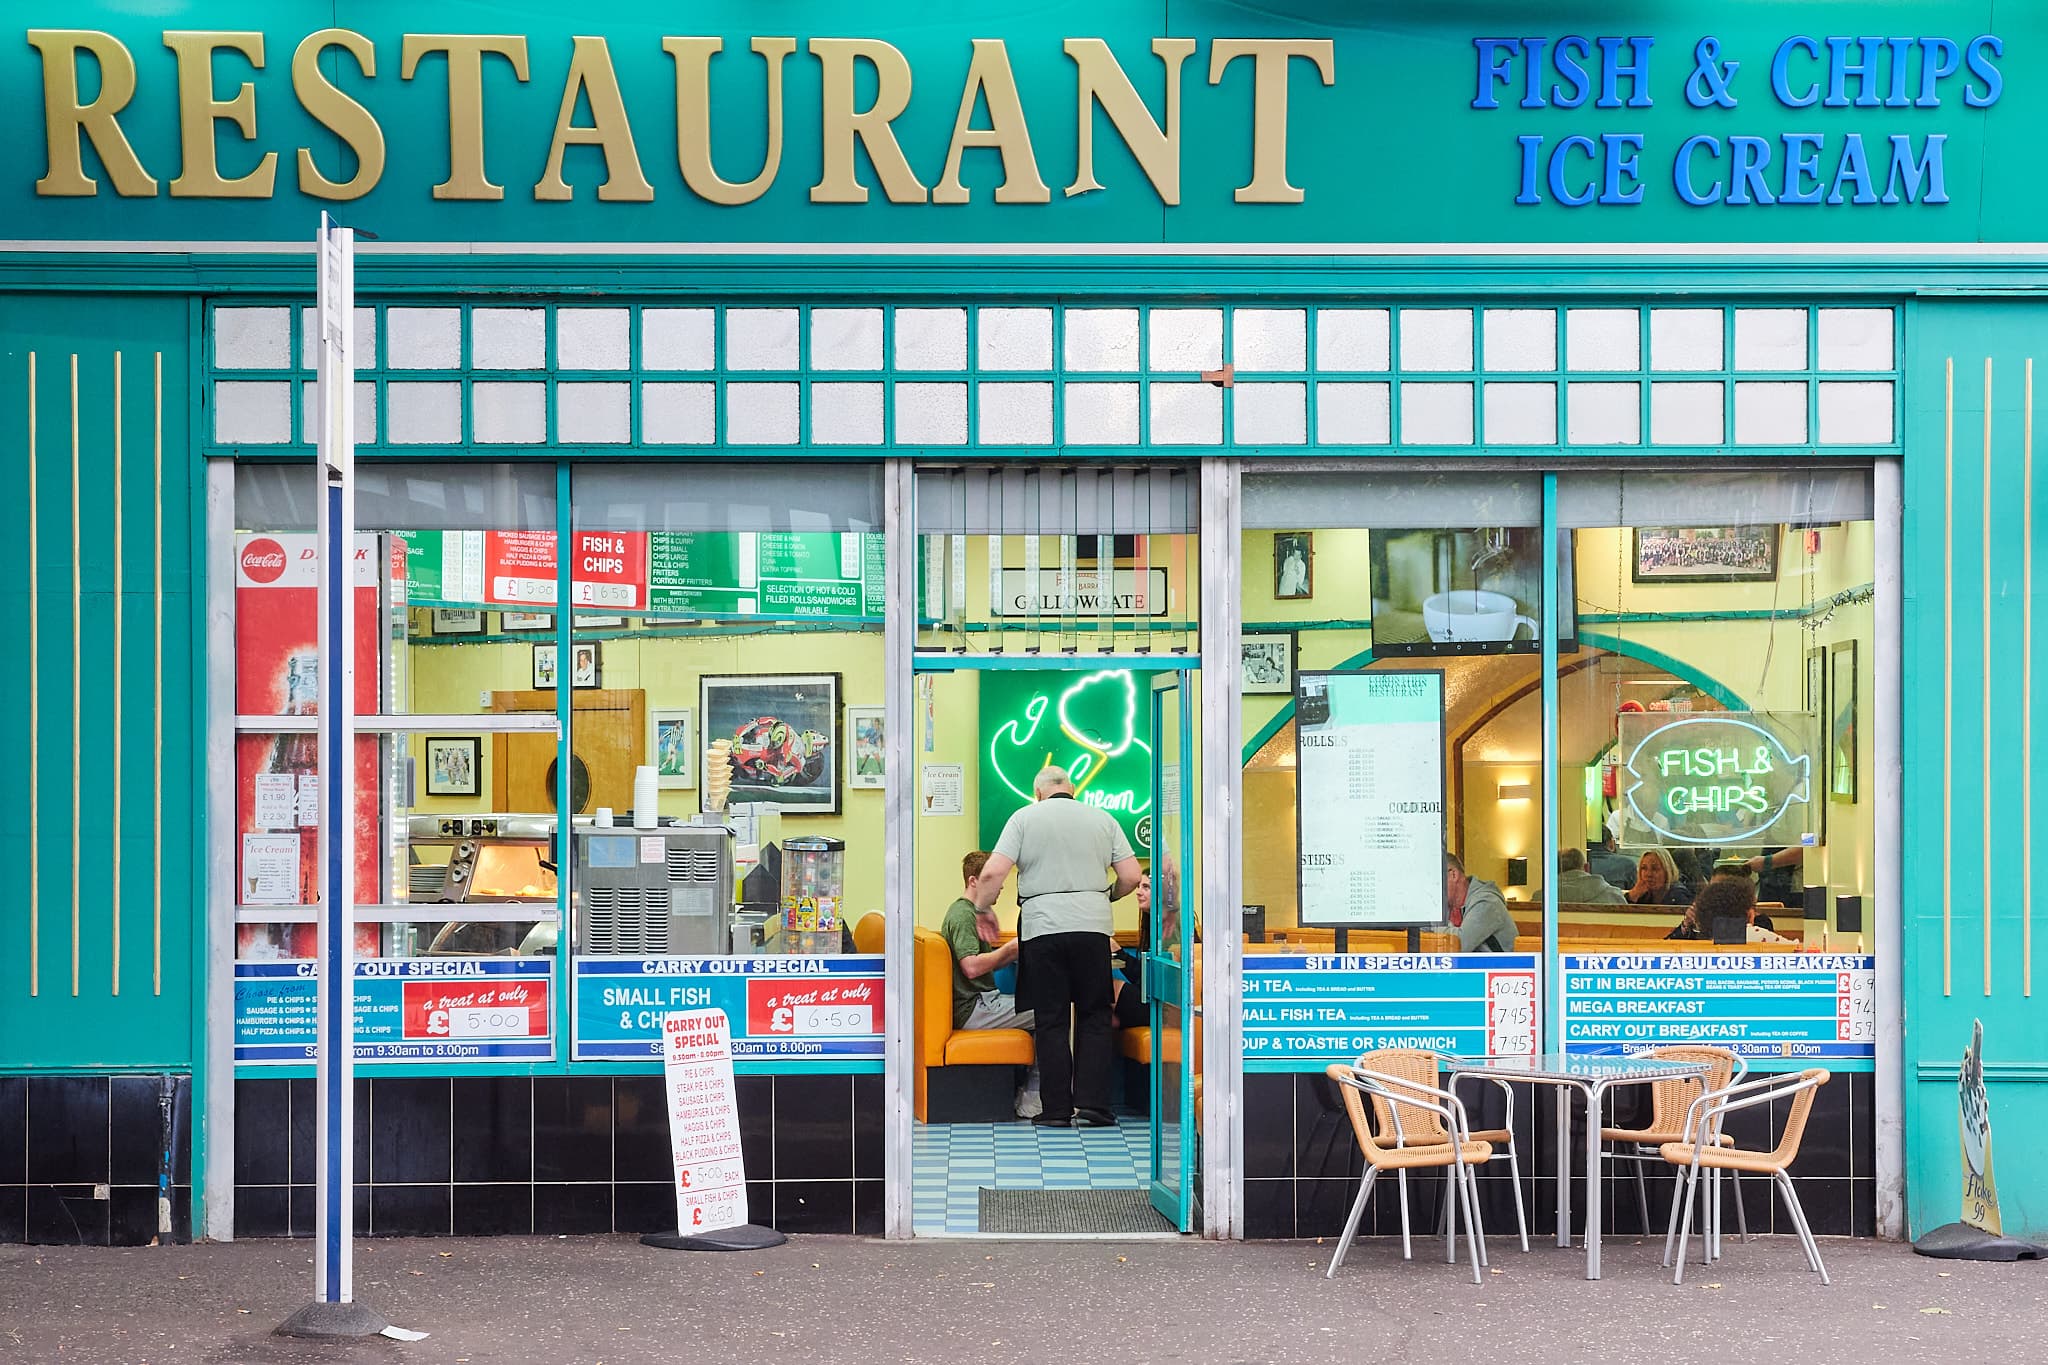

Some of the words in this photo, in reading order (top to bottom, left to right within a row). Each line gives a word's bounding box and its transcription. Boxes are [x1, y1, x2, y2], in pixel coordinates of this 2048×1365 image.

[1471, 35, 1654, 108] FISH
[1686, 36, 1737, 107] &
[1772, 35, 2003, 108] CHIPS
[27, 28, 1335, 206] RESTAURANT
[1515, 134, 1644, 205] ICE
[1674, 134, 1949, 205] CREAM
[583, 537, 612, 553] FISH
[615, 539, 624, 554] &
[584, 557, 623, 573] CHIPS
[767, 585, 804, 593] SELECTION
[766, 595, 788, 603] FILLED
[790, 596, 856, 605] ROLLS/SANDWICHES
[1015, 595, 1144, 609] GALLOWGATE
[795, 606, 828, 614] AVAILABLE
[1662, 749, 1740, 776] FISH
[1667, 786, 1768, 814] CHIPS
[1389, 802, 1417, 813] COLD
[365, 963, 402, 975] OUT
[409, 962, 485, 975] SPECIAL
[642, 961, 703, 974] CARRY
[709, 960, 748, 973] OUT
[752, 960, 829, 973] SPECIAL
[1306, 957, 1335, 970] SIT
[1341, 957, 1359, 969] IN
[1365, 956, 1452, 970] SPECIALS
[1576, 957, 1615, 969] TRY
[1617, 957, 1656, 969] OUT
[1661, 957, 1755, 969] FABULOUS
[1761, 957, 1866, 969] BREAKFAST
[1264, 980, 1292, 992] TEA
[1571, 978, 1593, 989] SIT
[1597, 978, 1611, 989] IN
[1616, 978, 1704, 989] BREAKFAST
[1839, 975, 1849, 991] £
[279, 985, 305, 997] from
[424, 1000, 433, 1010] a
[439, 993, 474, 1008] treat
[478, 991, 495, 1004] at
[499, 985, 528, 1003] only
[604, 988, 665, 1005] SMALL
[671, 988, 711, 1005] FISH
[767, 997, 778, 1008] a
[783, 992, 816, 1006] treat
[822, 989, 838, 1002] at
[842, 983, 871, 999] only
[1570, 1002, 1612, 1013] MEGA
[1617, 1001, 1705, 1013] BREAKFAST
[620, 1013, 633, 1028] &
[771, 1008, 792, 1032] £
[1281, 1009, 1312, 1020] FISH
[1318, 1009, 1346, 1020] TEA
[427, 1011, 448, 1034] £
[667, 1018, 701, 1032] CARRY
[705, 1016, 724, 1028] OUT
[1570, 1025, 1621, 1036] CARRY
[1625, 1025, 1656, 1036] OUT
[1660, 1025, 1748, 1036] BREAKFAST
[675, 1033, 719, 1048] SPECIAL
[1272, 1038, 1282, 1048] &
[1286, 1038, 1348, 1049] TOASTIE
[1352, 1038, 1373, 1049] OR
[1378, 1036, 1456, 1048] SANDWICH
[378, 1046, 419, 1056] 9.30am
[423, 1046, 433, 1055] to
[437, 1046, 479, 1056] 8.00pm
[767, 1044, 777, 1052] to
[780, 1043, 822, 1053] 8.00pm
[1772, 1044, 1781, 1053] to
[700, 1067, 715, 1076] CHIPS
[677, 1083, 694, 1093] STEAK
[709, 1079, 724, 1088] CHIPS
[679, 1095, 703, 1106] SAUSAGE
[710, 1092, 725, 1102] CHIPS
[676, 1108, 709, 1119] HAMBURGER
[715, 1105, 730, 1115] CHIPS
[684, 1121, 704, 1132] HAGGIS
[710, 1119, 725, 1128] CHIPS
[681, 1136, 694, 1146] HALF
[696, 1135, 710, 1144] PIZZA
[716, 1131, 731, 1141] CHIPS
[676, 1150, 694, 1160] BLACK
[695, 1147, 718, 1158] PUDDING
[724, 1144, 739, 1153] CHIPS
[682, 1170, 691, 1187] £
[725, 1171, 739, 1181] EACH
[685, 1195, 704, 1206] SMALL
[705, 1193, 716, 1203] FISH
[723, 1190, 738, 1200] CHIPS
[693, 1208, 702, 1225] £
[1973, 1202, 1985, 1222] 99
